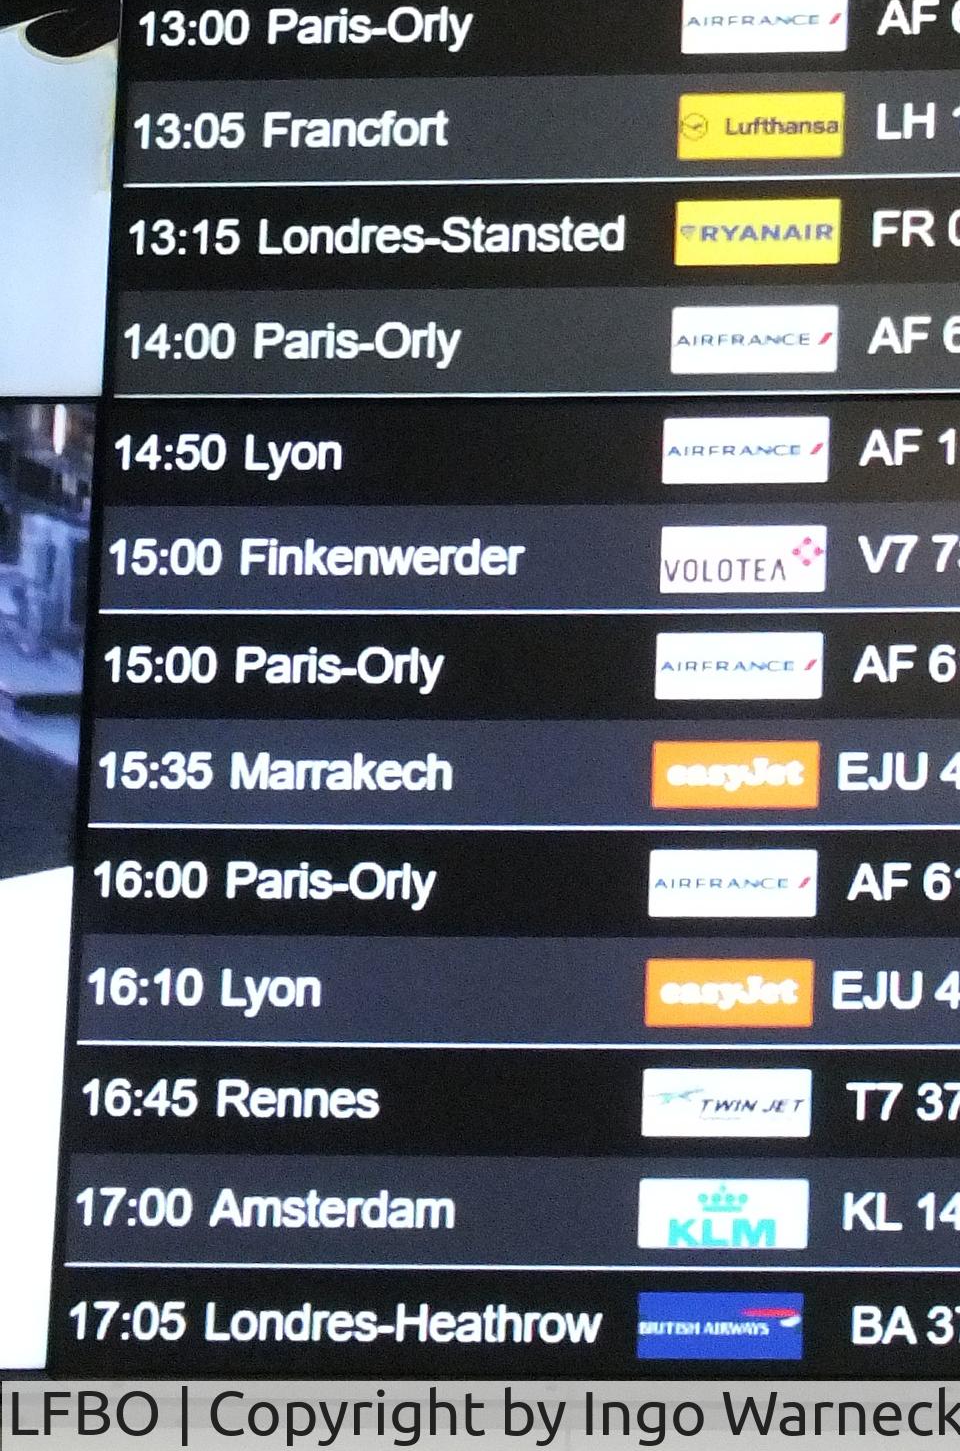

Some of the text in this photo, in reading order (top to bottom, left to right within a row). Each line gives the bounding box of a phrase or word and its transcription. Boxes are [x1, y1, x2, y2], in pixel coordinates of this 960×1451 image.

[139, 9, 250, 47] 13:00
[267, 5, 474, 53] Paris-Orly
[133, 111, 246, 150] 13:05
[263, 109, 450, 149] Francfort
[725, 116, 840, 136] Lufthansa
[129, 218, 241, 256] 13:15
[258, 214, 626, 255] Londres-Stansted
[700, 223, 834, 243] RYANAIR
[872, 209, 936, 248] FR
[124, 322, 236, 360] 14:00
[254, 321, 462, 370] Paris-Orly
[114, 433, 227, 471] 14:50
[244, 433, 342, 481] Lyon
[858, 427, 923, 467] AF
[109, 537, 223, 576] 15:00
[240, 537, 526, 576] Finkenwerder
[663, 558, 787, 583] VOLOTEA
[104, 645, 218, 684] 15:00
[235, 646, 445, 695] Paris-Orly
[852, 644, 918, 684] AF
[98, 750, 214, 790] 15:35
[230, 751, 453, 791] Marrakech
[666, 756, 805, 792] easyJet
[93, 860, 208, 899] 16:00
[226, 860, 437, 911] Paris-Orly
[846, 862, 912, 902] AF
[87, 967, 204, 1007] 16:10
[221, 968, 322, 1018] Lyon
[82, 1077, 199, 1118] 16:45
[216, 1078, 380, 1119] Rennes
[700, 1098, 806, 1114] TWIN JET
[845, 1082, 904, 1122] T7
[76, 1186, 193, 1227] 17:00
[209, 1187, 456, 1229] Amsterdam
[667, 1217, 777, 1248] KLM
[69, 1300, 187, 1341] 17:05
[204, 1301, 603, 1344] Londres-Heathrow
[852, 1305, 918, 1345] BA
